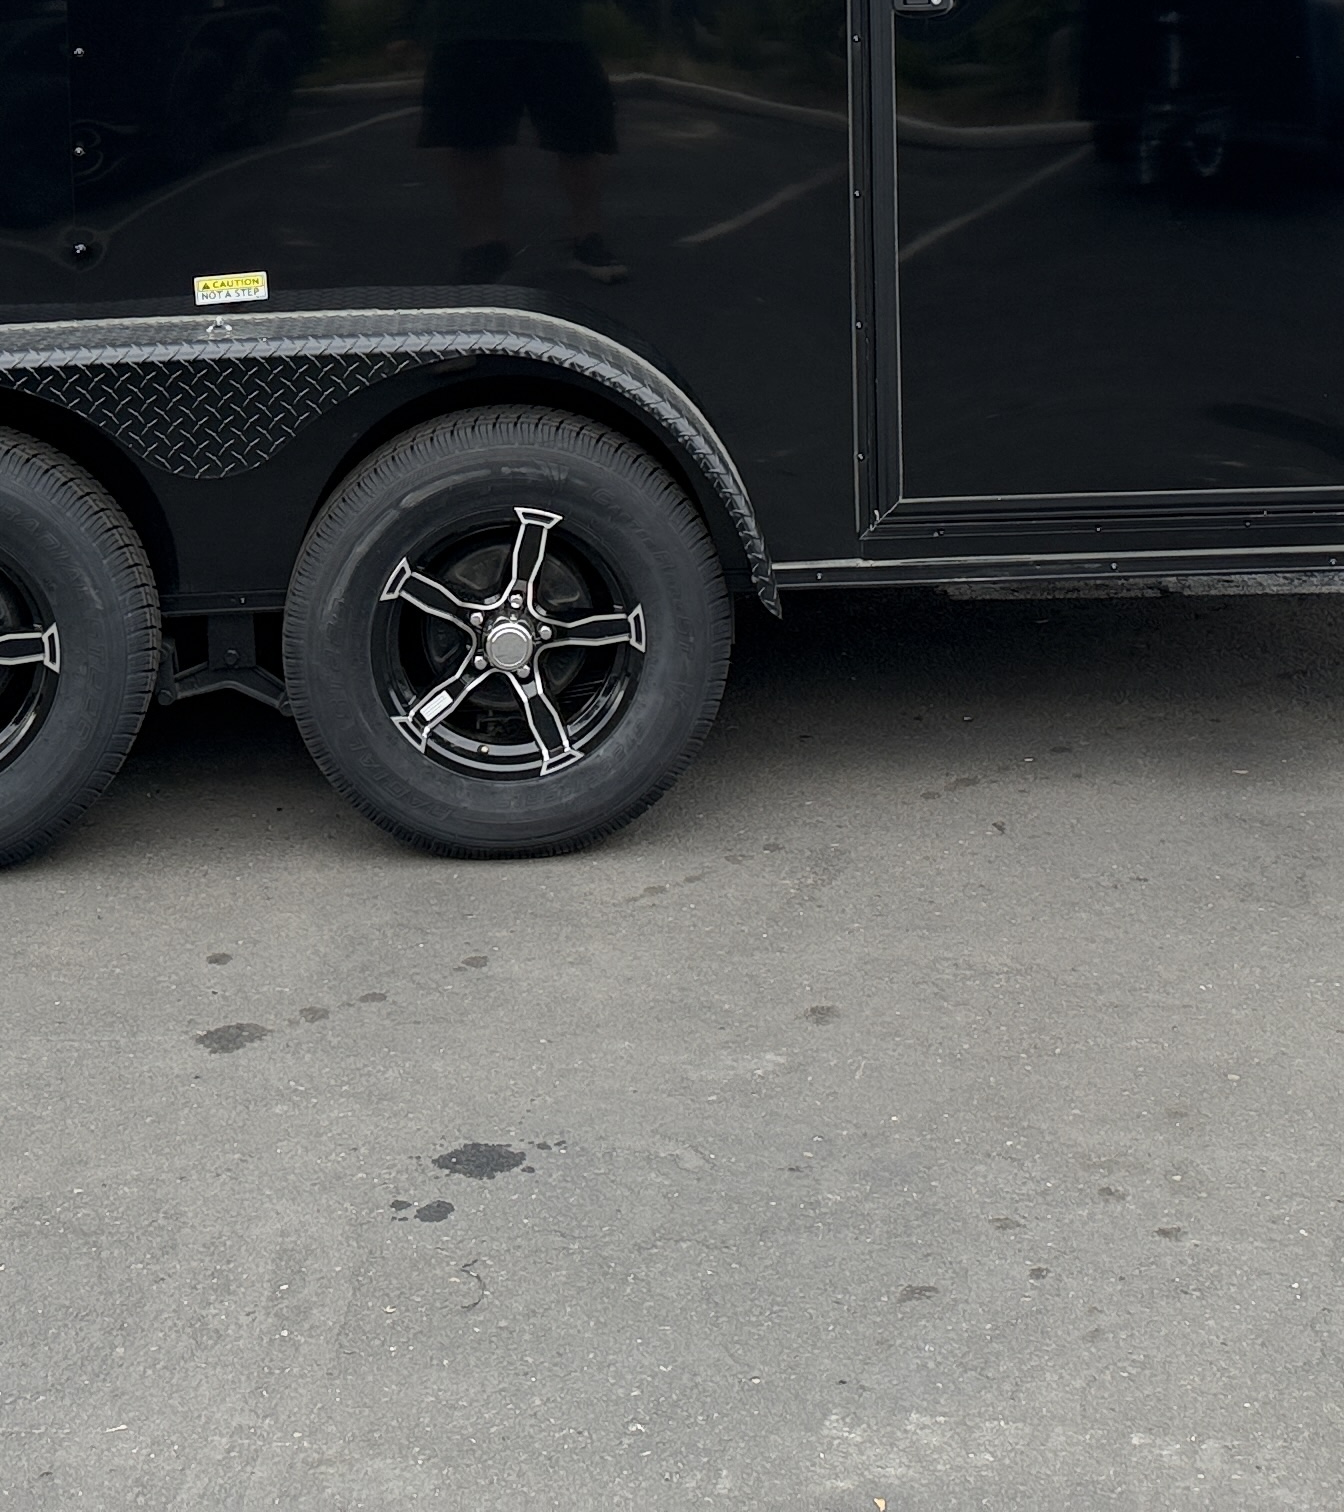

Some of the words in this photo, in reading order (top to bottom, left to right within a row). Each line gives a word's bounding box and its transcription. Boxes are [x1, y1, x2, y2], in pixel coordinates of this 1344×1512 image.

[212, 277, 260, 289] CAUTION
[201, 290, 223, 301] NOT
[224, 289, 232, 298] A
[235, 287, 260, 298] STEP
